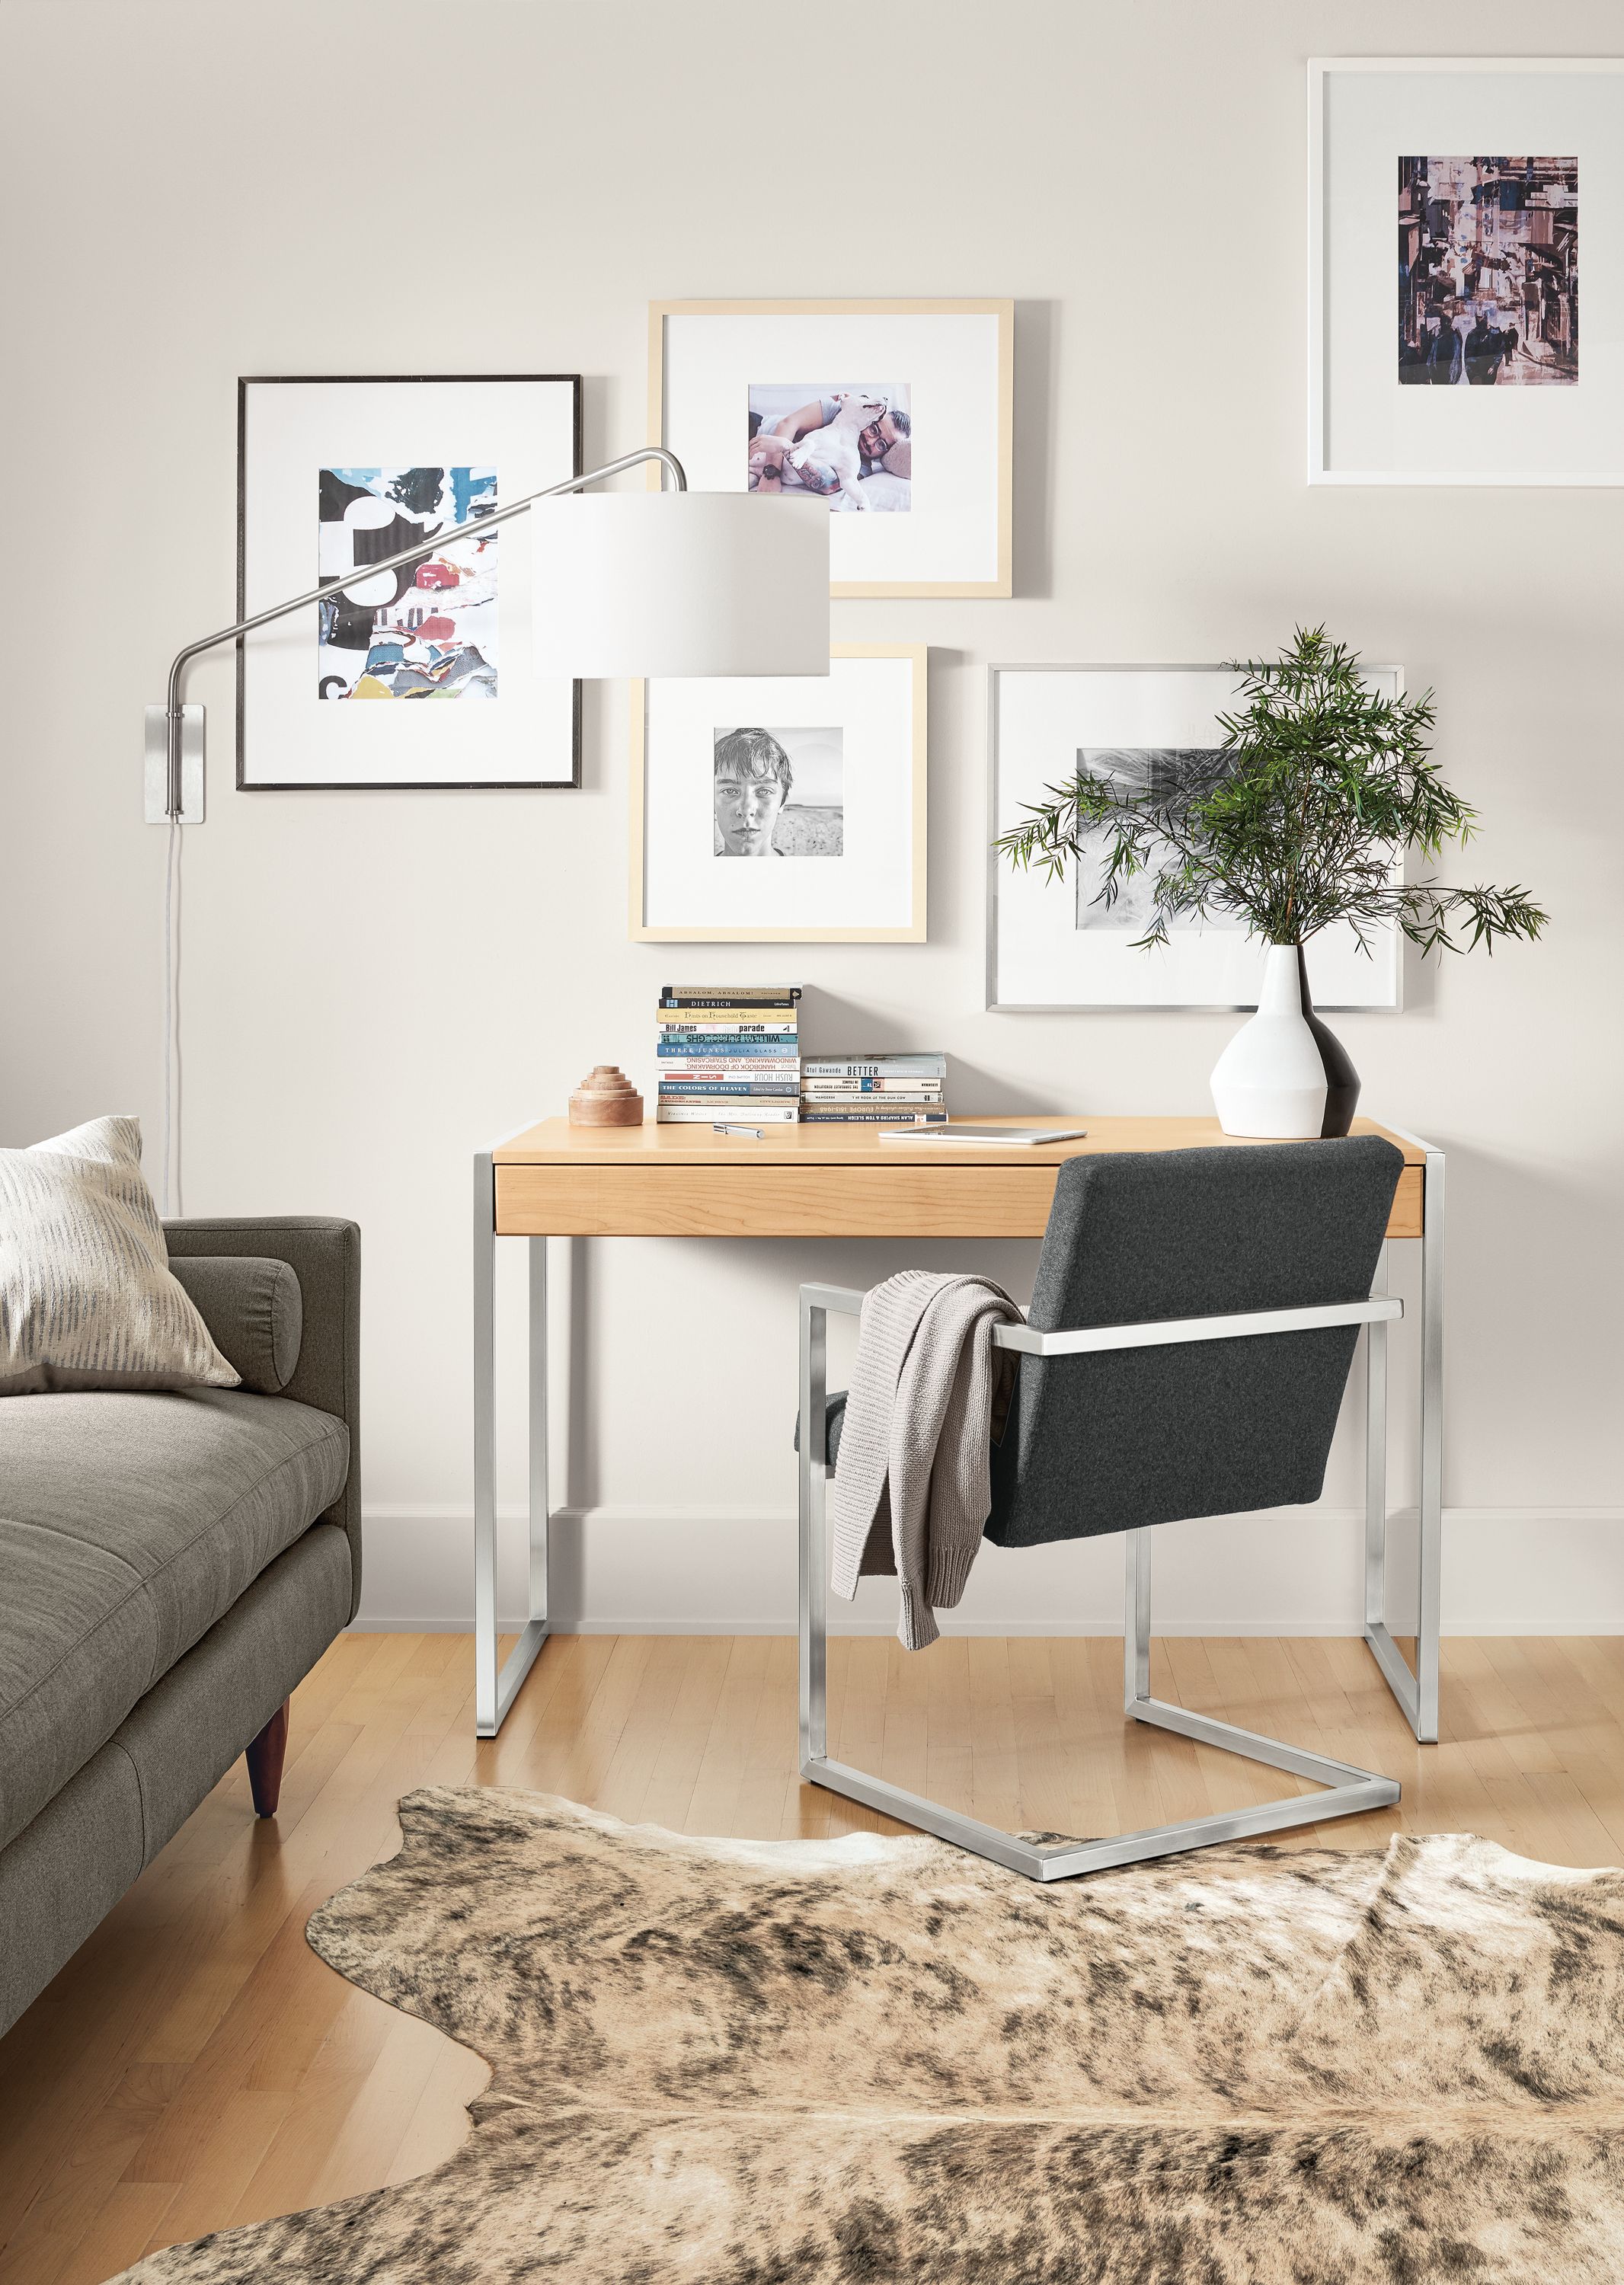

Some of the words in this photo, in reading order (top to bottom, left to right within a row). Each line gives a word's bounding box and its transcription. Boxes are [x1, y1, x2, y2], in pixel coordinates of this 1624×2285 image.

[739, 1024, 765, 1033] parade
[847, 1066, 878, 1075] BETTER
[776, 1073, 792, 1082] RUSH
